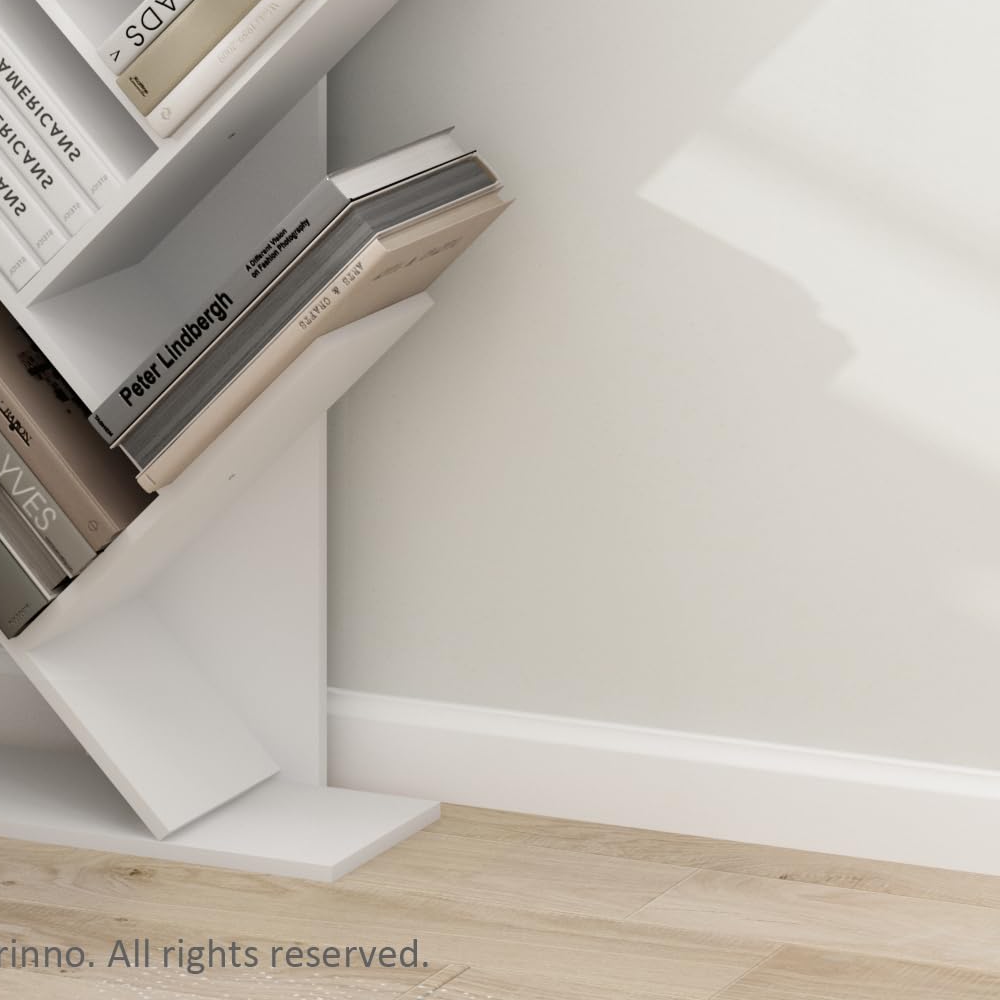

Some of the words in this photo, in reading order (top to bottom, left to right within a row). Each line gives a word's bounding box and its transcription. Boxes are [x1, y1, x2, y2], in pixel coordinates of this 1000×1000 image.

[249, 243, 272, 265] Different
[269, 228, 288, 246] Vision
[251, 269, 260, 278] on
[256, 248, 280, 271] Fashion
[276, 218, 311, 251] Photography
[331, 285, 341, 296] &
[340, 261, 365, 286] ARTS
[297, 295, 332, 330] CRAFTS
[119, 362, 162, 406] Peter
[156, 290, 234, 370] Lindbergh
